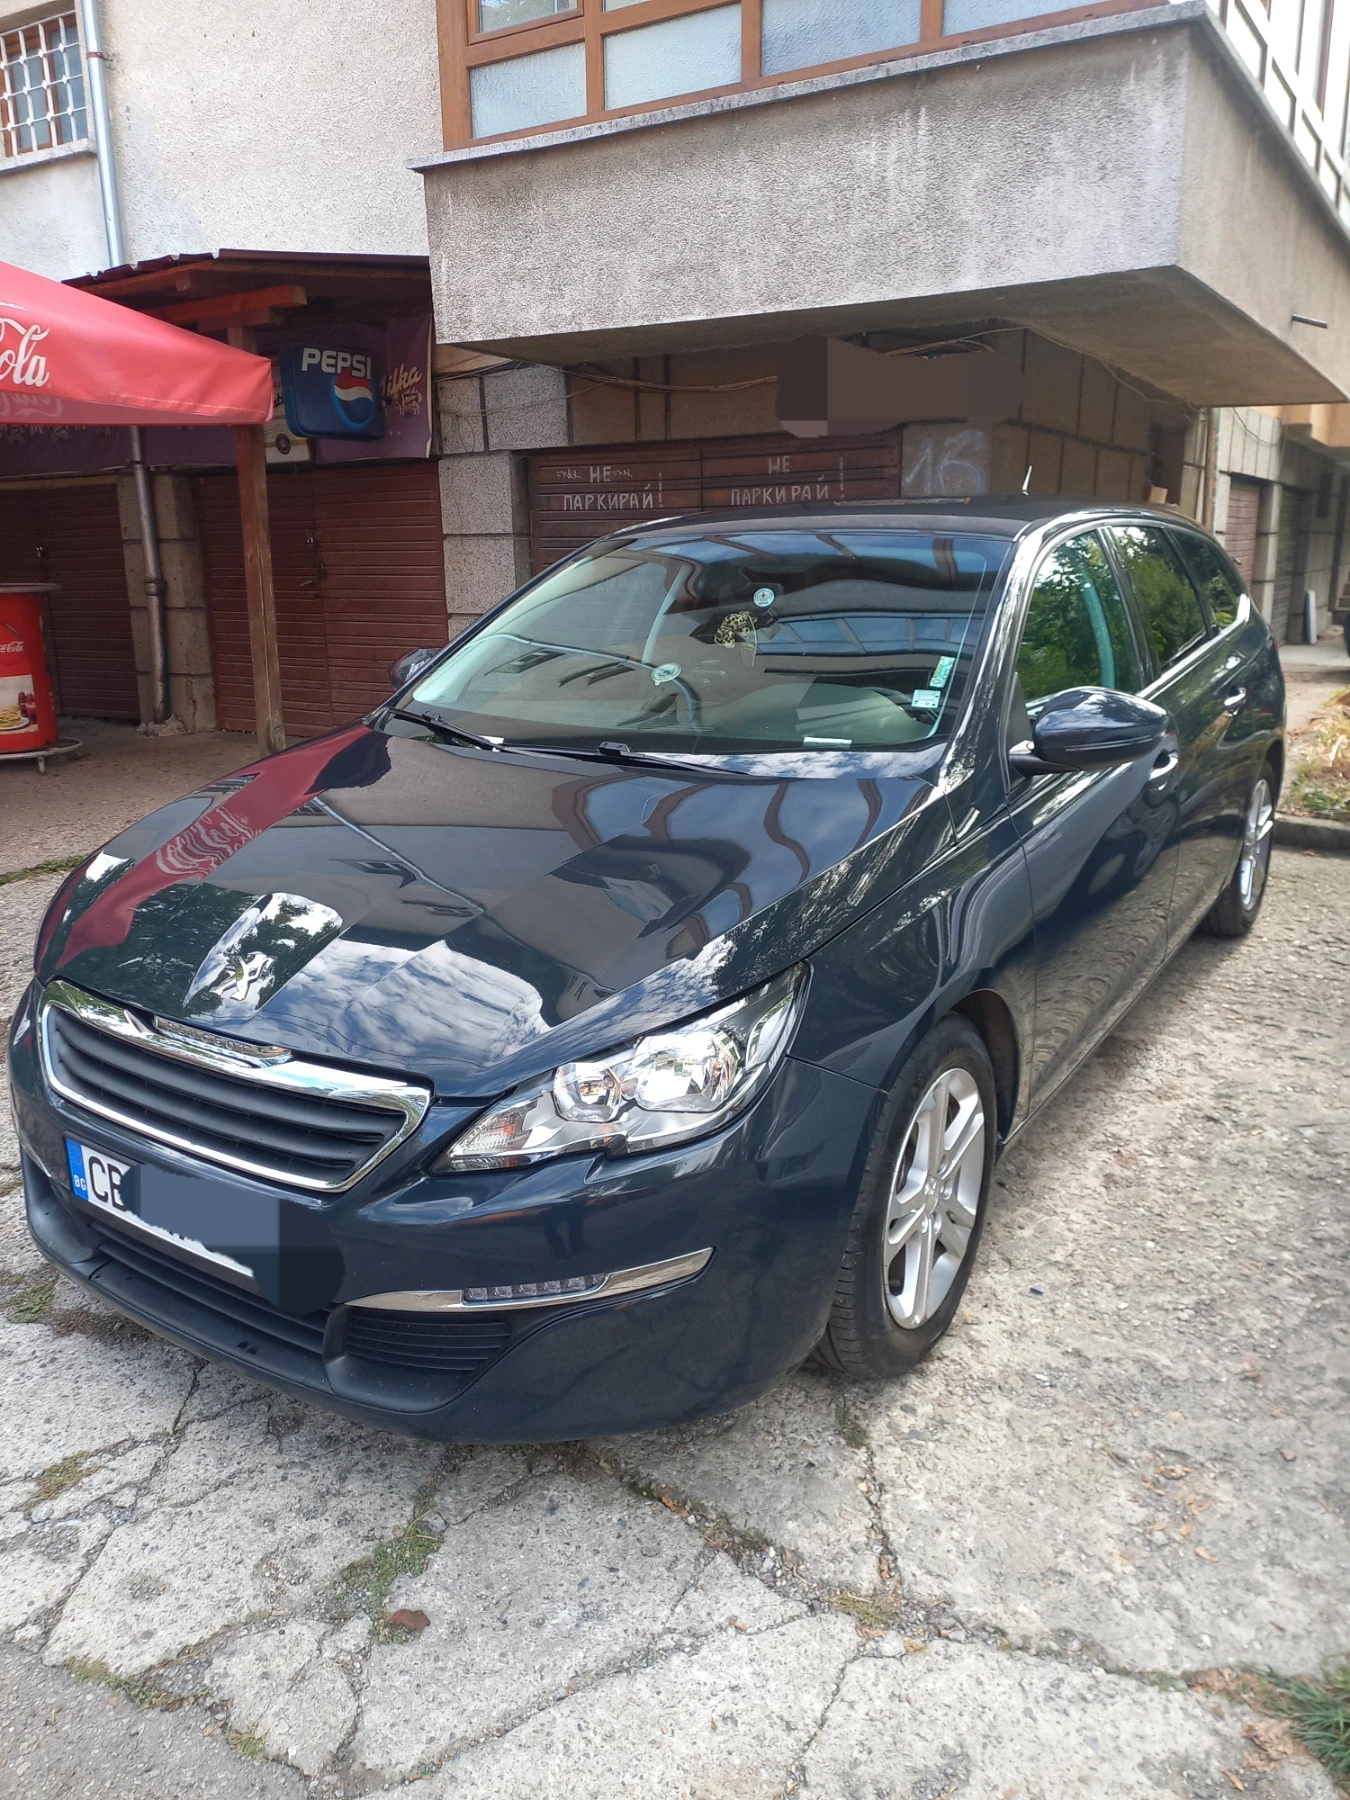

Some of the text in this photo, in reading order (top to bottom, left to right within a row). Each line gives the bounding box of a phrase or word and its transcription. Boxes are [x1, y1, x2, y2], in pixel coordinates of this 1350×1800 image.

[302, 348, 372, 380] PEPSI
[589, 465, 612, 483] НЕ
[768, 455, 791, 475] НЕ
[903, 429, 986, 496] 16
[167, 1022, 248, 1053] PEUGEOT
[73, 1174, 87, 1191] BG
